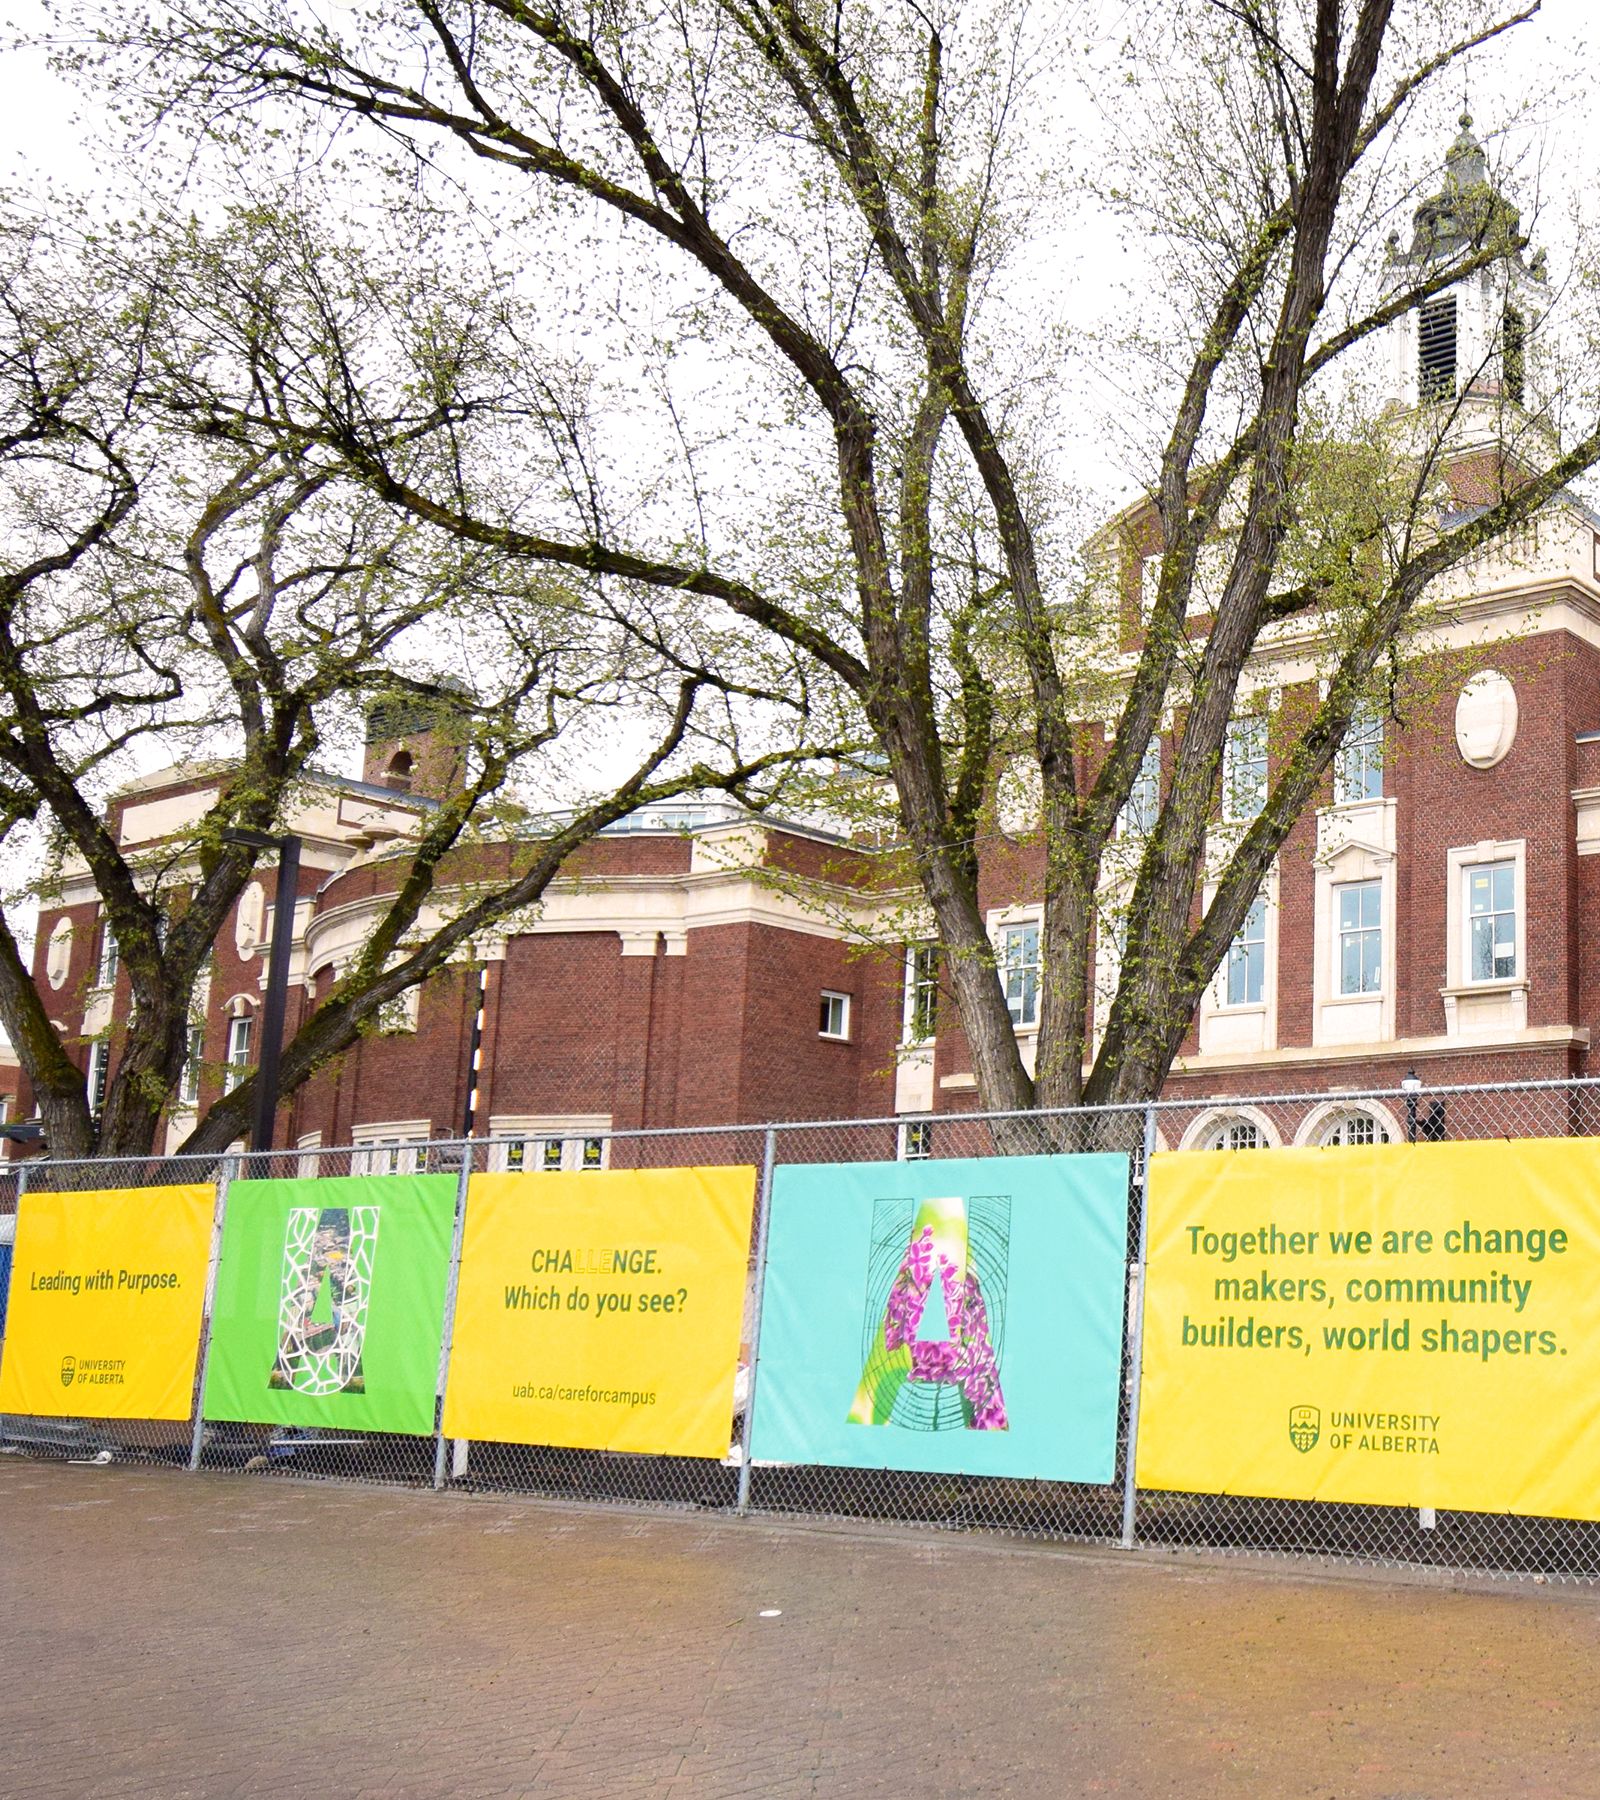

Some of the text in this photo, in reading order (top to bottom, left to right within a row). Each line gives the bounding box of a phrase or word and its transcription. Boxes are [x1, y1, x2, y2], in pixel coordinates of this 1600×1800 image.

[1185, 1220, 1569, 1263] Together we are change
[531, 1248, 663, 1275] CHALLENGE.
[30, 1269, 181, 1296] Leading with Purpose.
[1214, 1269, 1533, 1313] makers, community
[504, 1284, 688, 1319] Which do you see?
[1181, 1315, 1568, 1363] builders, world shapers.
[79, 1359, 126, 1371] UNIVERSITY
[78, 1373, 125, 1385] OF ALBERTA
[512, 1382, 656, 1409] uab.ca/careforcampus
[1331, 1412, 1441, 1432] UNIVERSITY
[1330, 1433, 1440, 1455] OF ALBERTA
